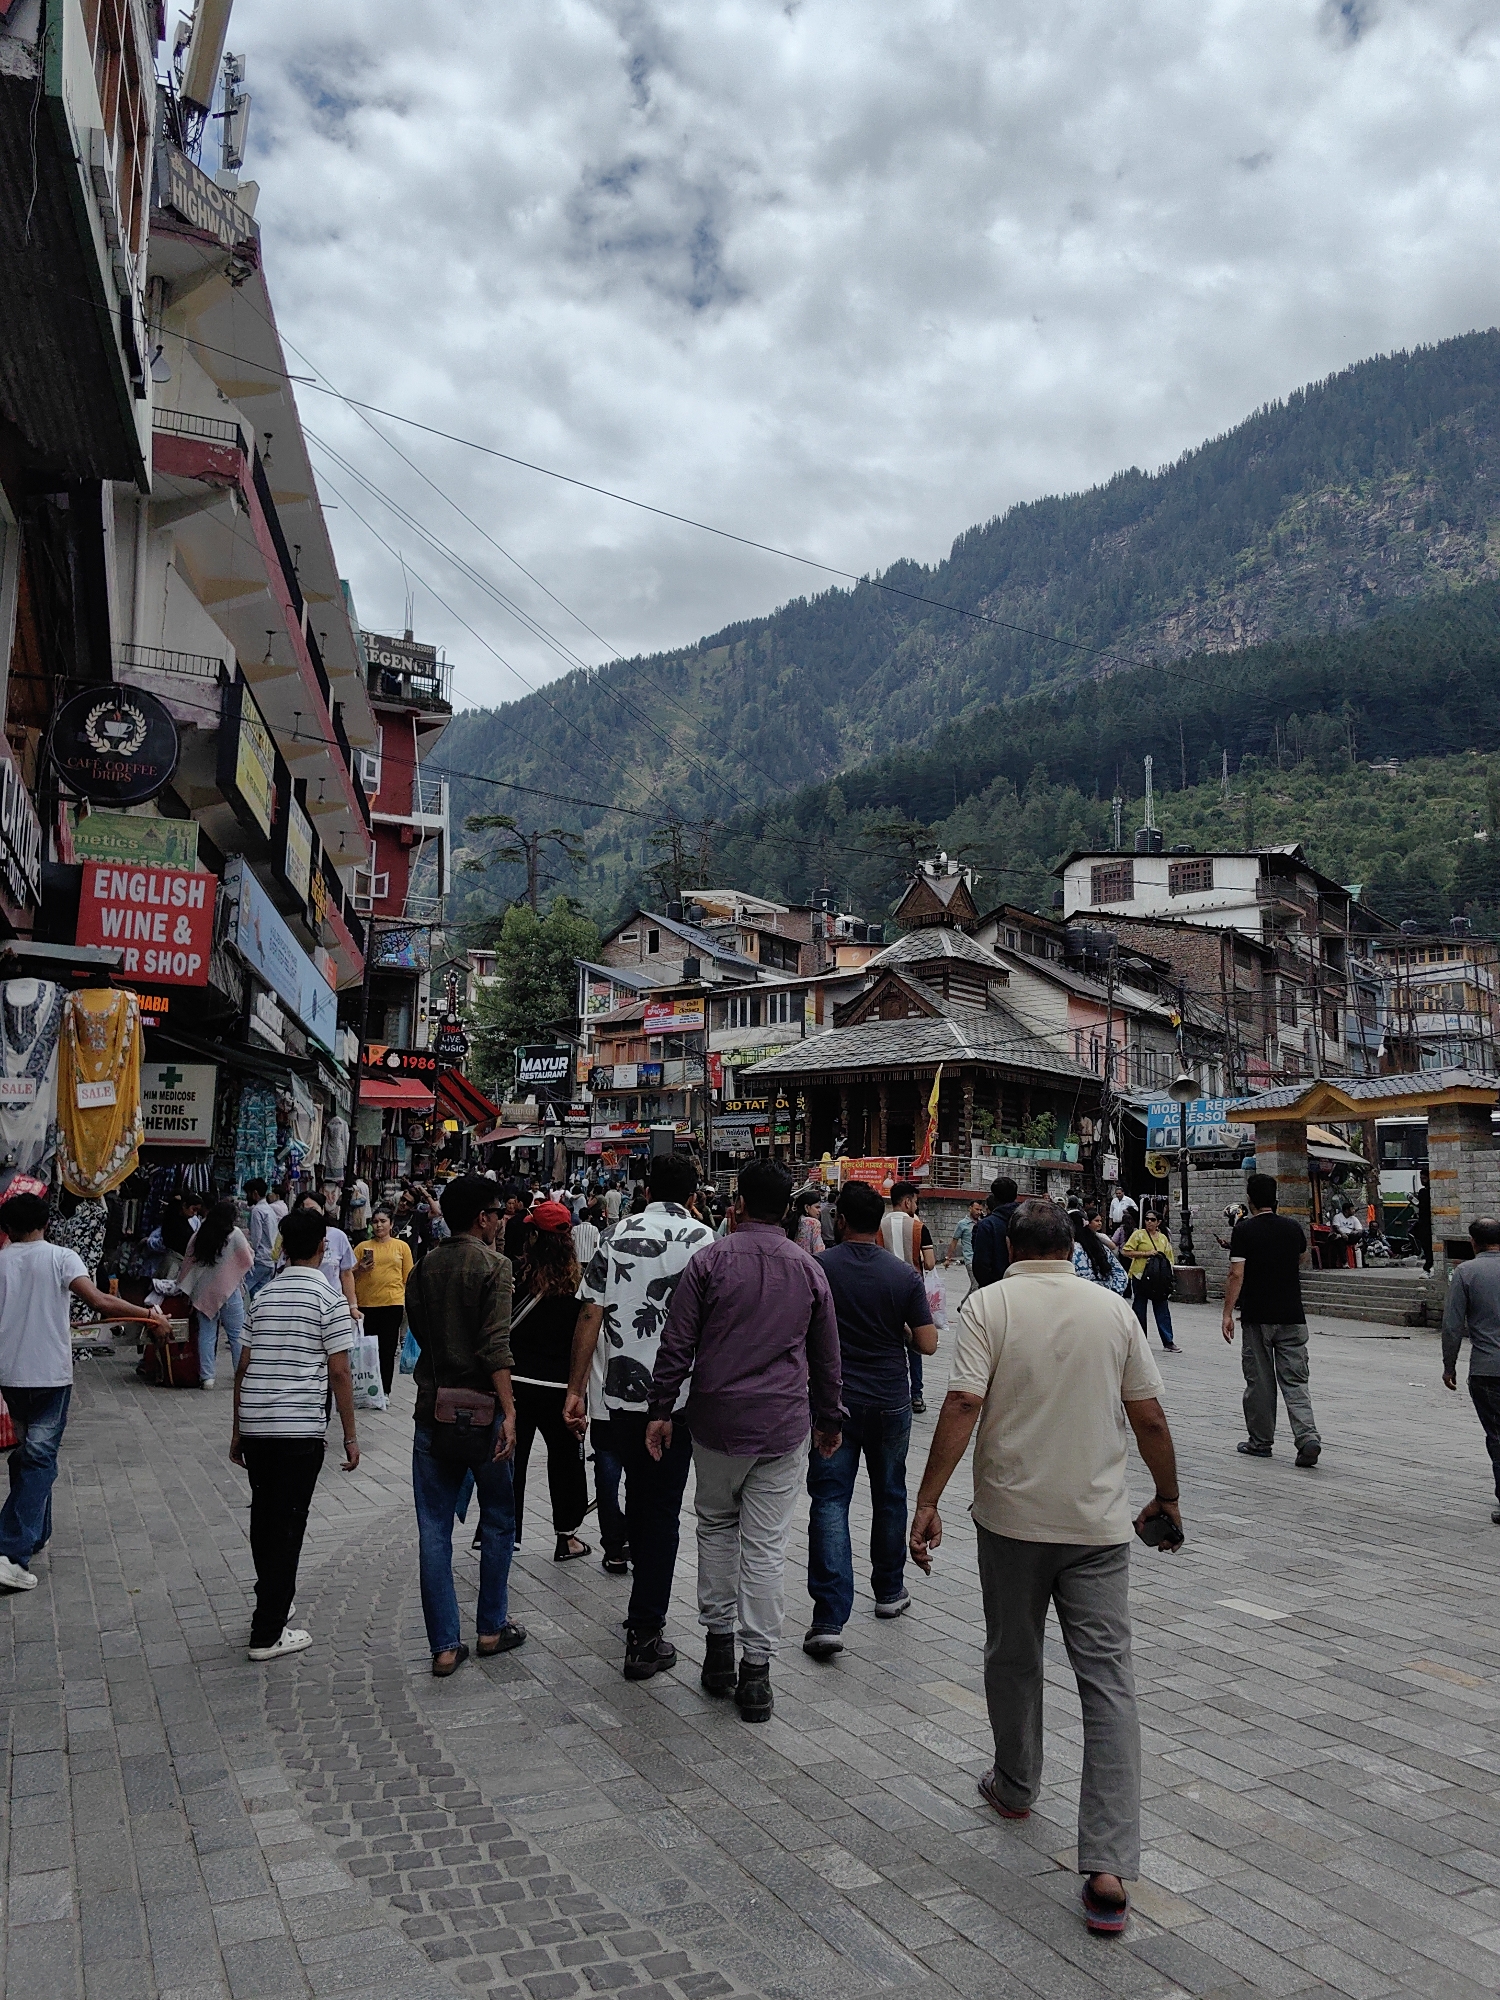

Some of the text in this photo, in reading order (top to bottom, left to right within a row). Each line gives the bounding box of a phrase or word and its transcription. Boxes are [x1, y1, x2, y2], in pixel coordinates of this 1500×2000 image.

[192, 166, 252, 238] HOTEL
[172, 174, 236, 246] HIGHWAY
[105, 761, 158, 776] COFFEE
[92, 769, 132, 783] DRIPS
[94, 868, 206, 909] ENGLISH
[101, 907, 192, 945] WINE &
[143, 949, 202, 977] SHOP
[443, 1025, 461, 1033] 1986
[441, 1035, 461, 1044] LIVE
[403, 1055, 436, 1070] 1986
[520, 1057, 569, 1072] MAYUR
[520, 1070, 567, 1081] RESTAURANT
[1, 1084, 33, 1095] SALE
[82, 1086, 112, 1100] SALE
[143, 1090, 196, 1101] HIM MEDICOSE
[151, 1104, 185, 1115] STORE
[725, 1101, 742, 1111] 3D
